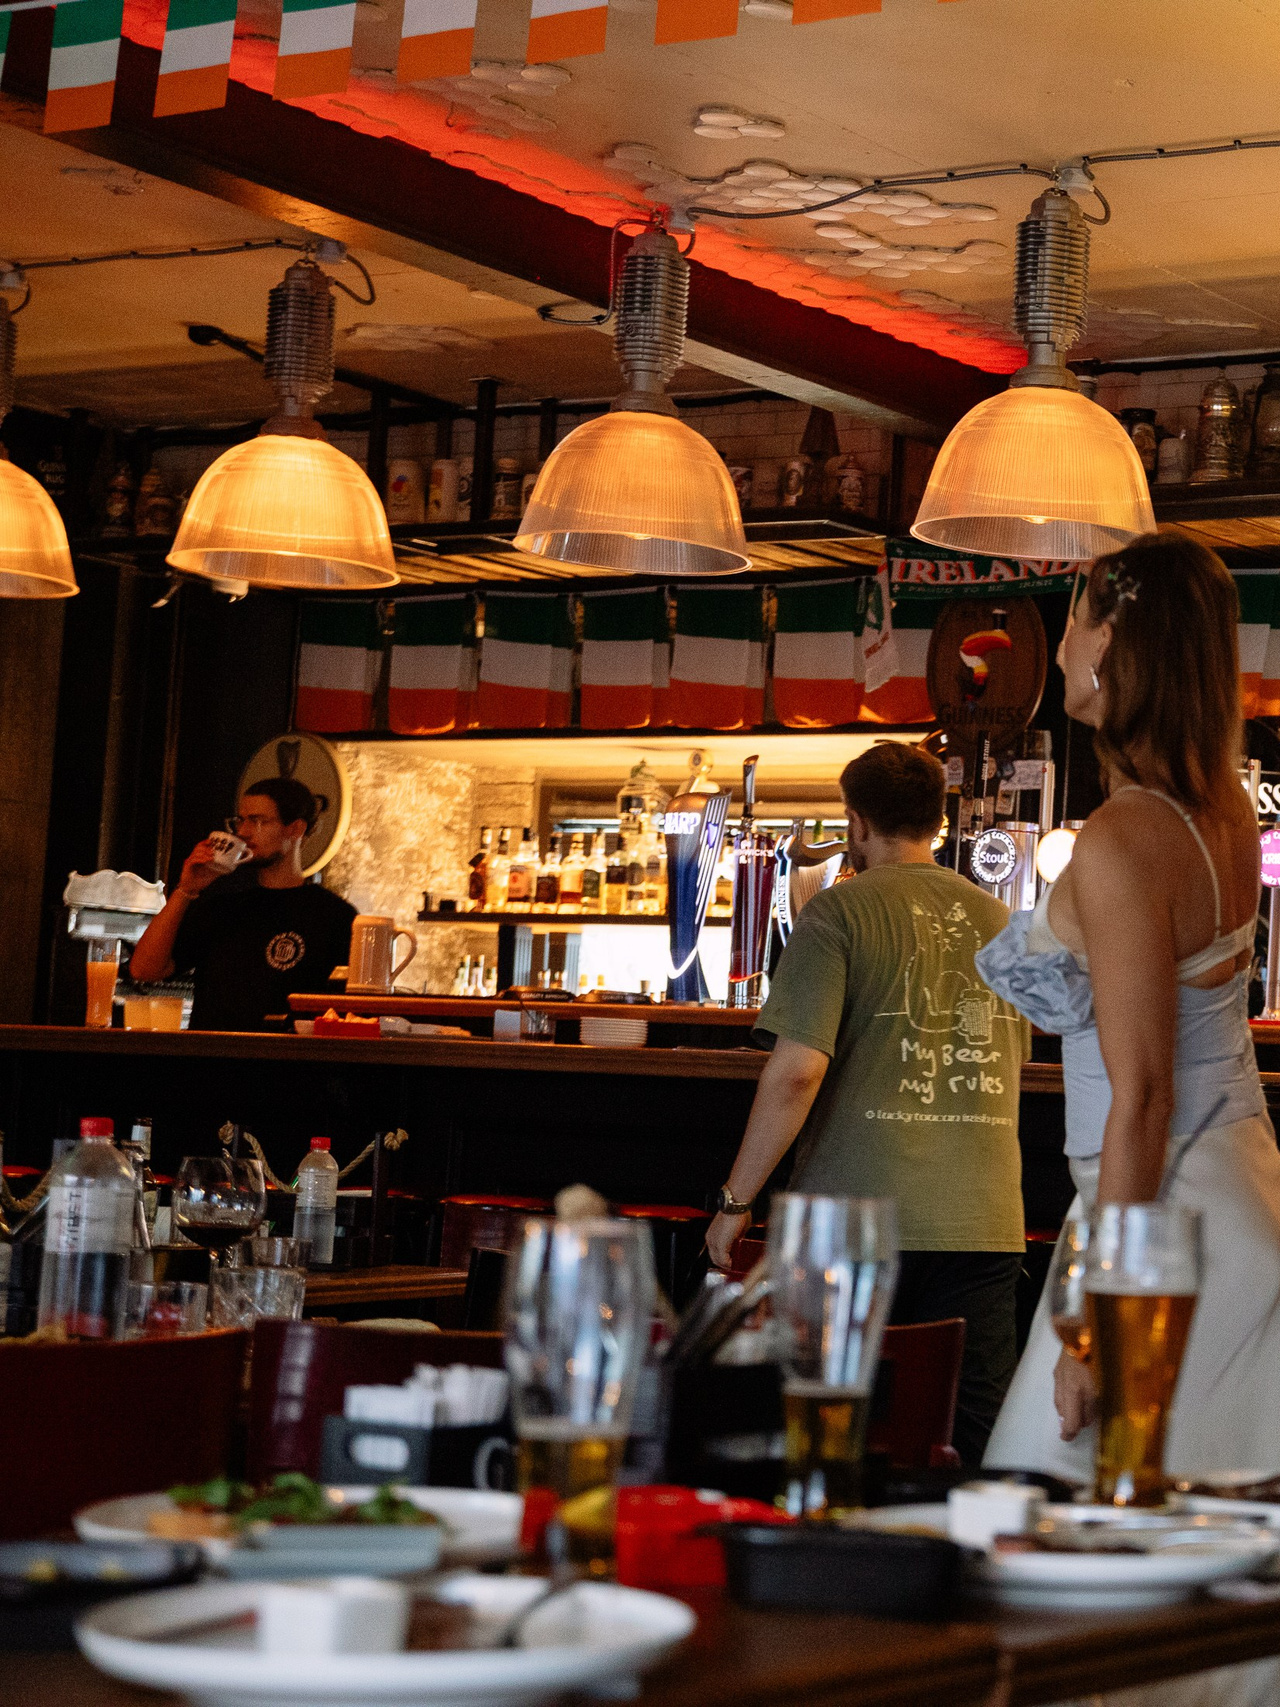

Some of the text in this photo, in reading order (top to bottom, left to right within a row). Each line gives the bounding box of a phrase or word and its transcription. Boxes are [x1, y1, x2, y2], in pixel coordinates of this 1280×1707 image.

[889, 557, 1081, 585] IRELAND
[938, 702, 1026, 726] GUINNESS
[979, 851, 1009, 864] Stout
[778, 875, 787, 924] GUINNESS
[900, 1037, 1002, 1078] My Beer
[948, 1071, 1005, 1095] rules
[876, 1109, 913, 1123] lucky
